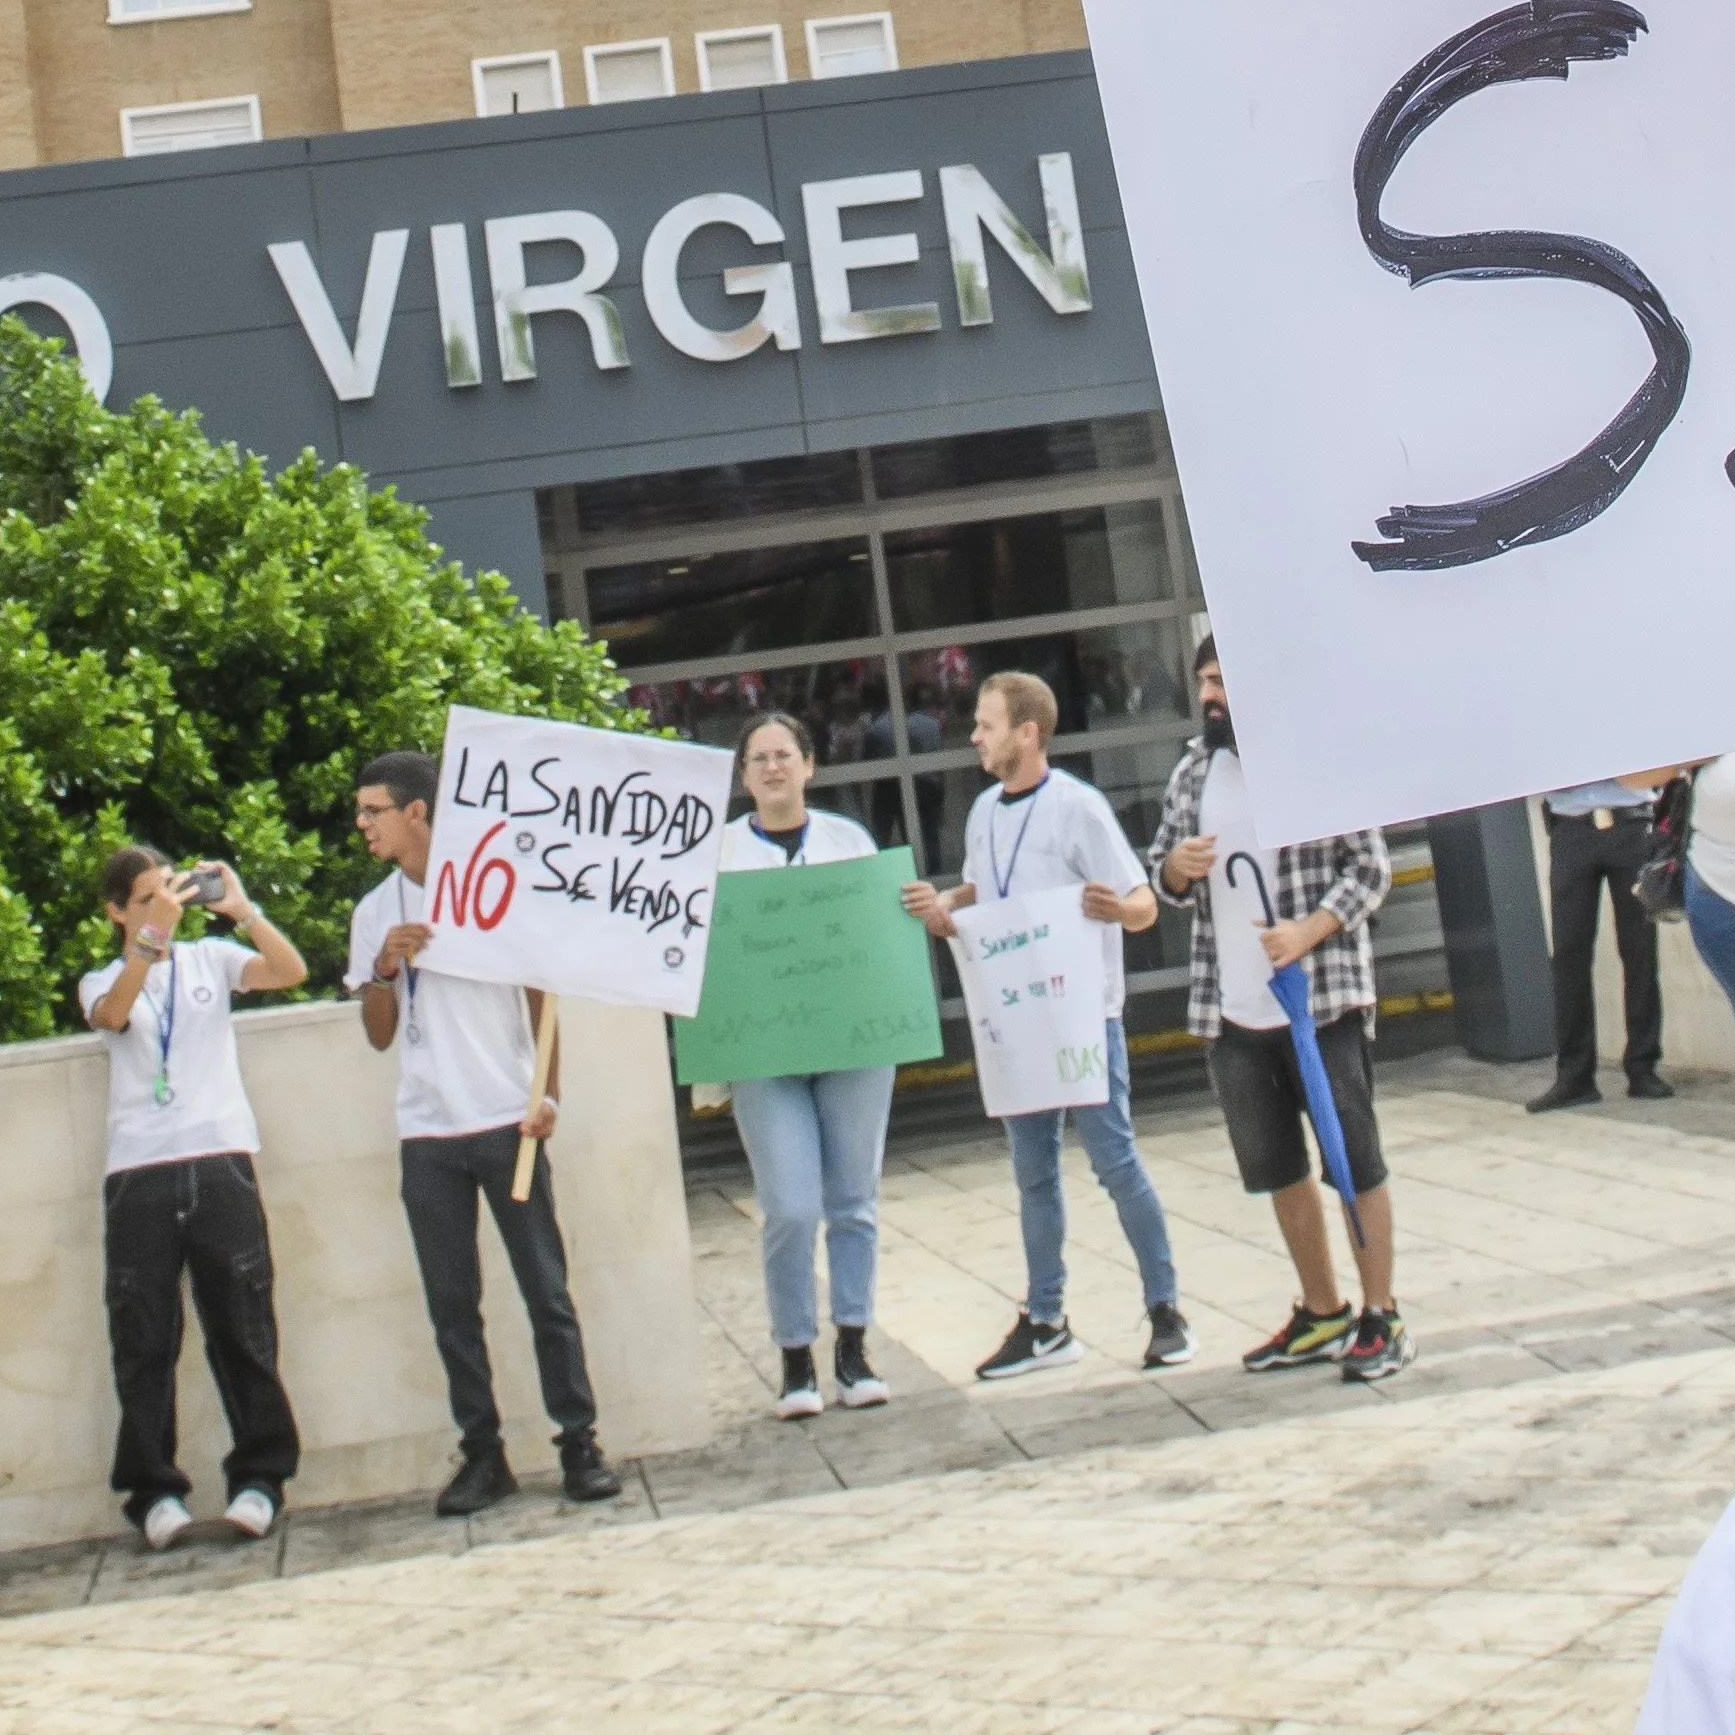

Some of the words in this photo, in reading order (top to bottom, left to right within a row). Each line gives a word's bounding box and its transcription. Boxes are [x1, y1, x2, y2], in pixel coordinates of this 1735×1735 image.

[267, 151, 1092, 402] VIRGEN
[453, 746, 509, 813] LA
[431, 819, 516, 932] NO
